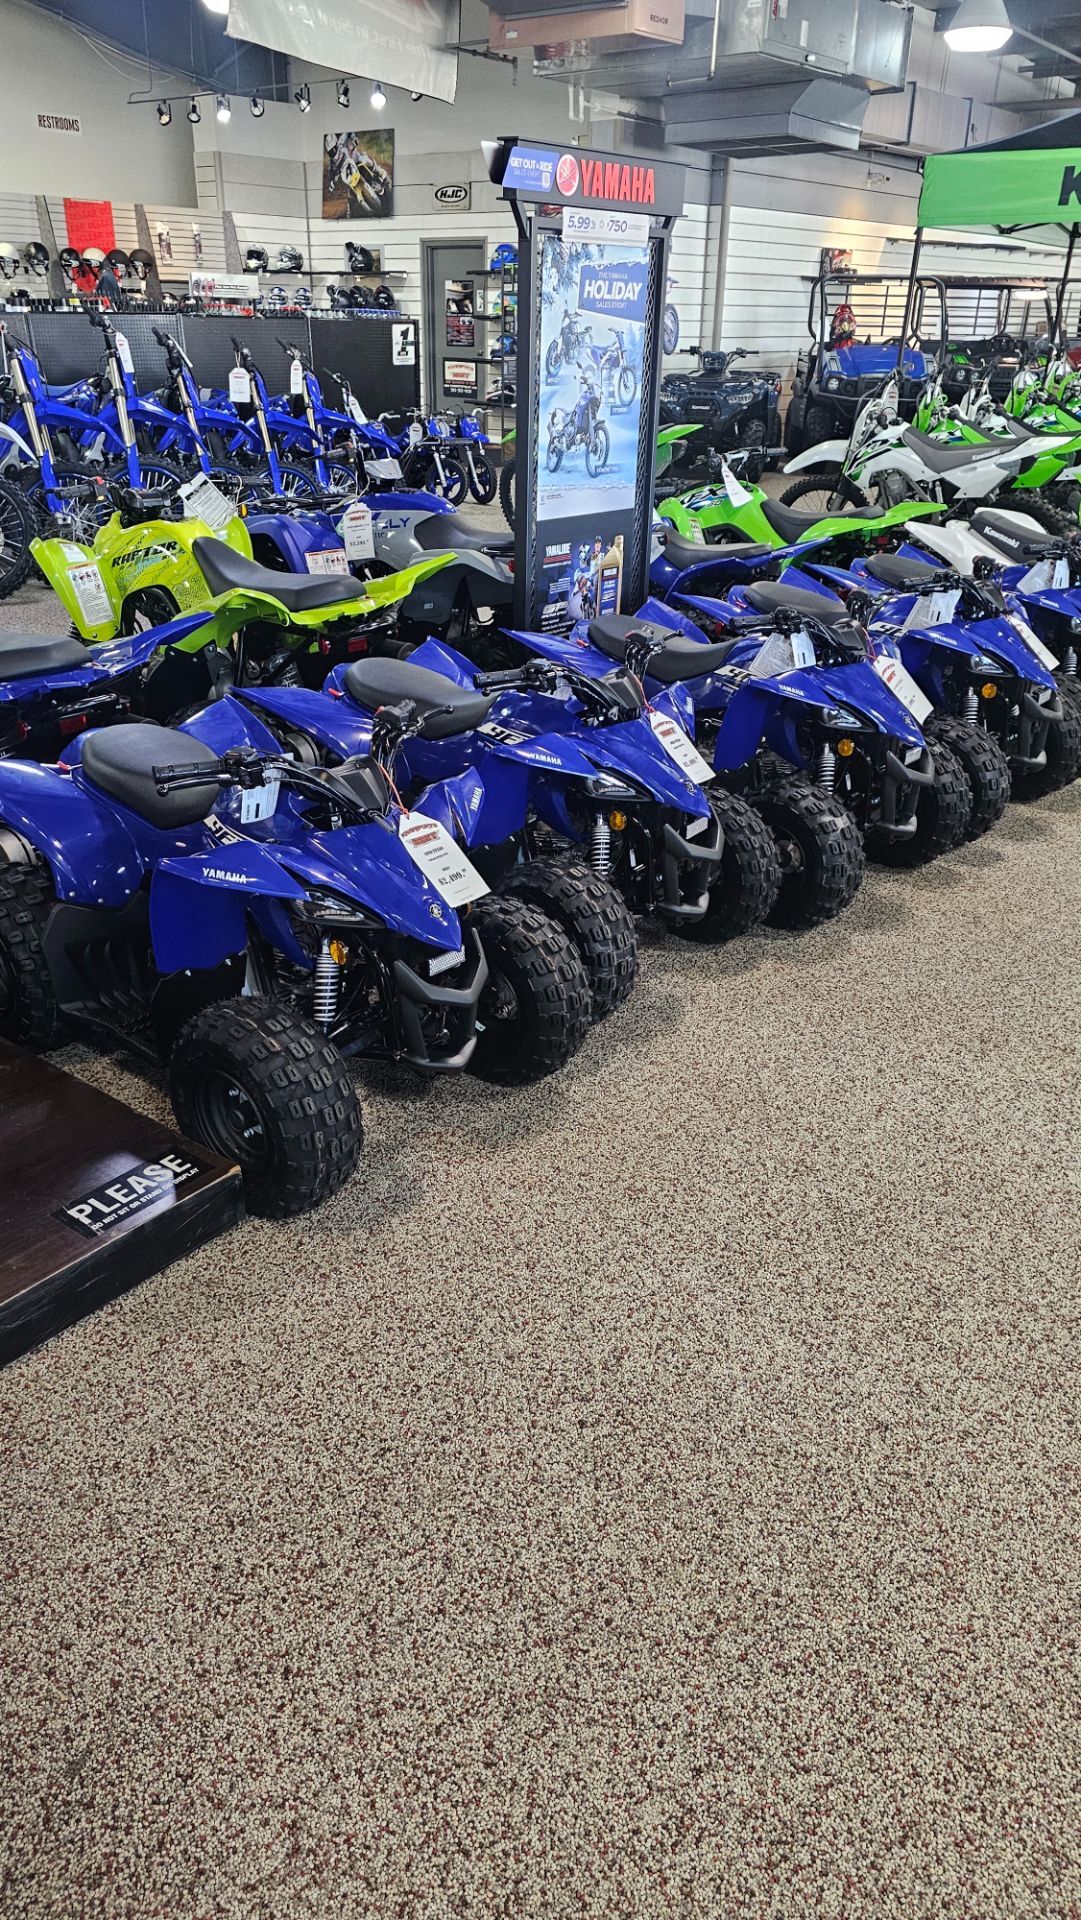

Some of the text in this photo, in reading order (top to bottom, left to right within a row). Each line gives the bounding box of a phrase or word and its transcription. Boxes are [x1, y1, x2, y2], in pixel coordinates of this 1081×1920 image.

[38, 114, 80, 132] RESTROOMS
[510, 157, 523, 168] GET
[523, 158, 536, 170] OUT
[540, 161, 553, 172] RIDE
[580, 158, 655, 205] YAMAHA
[440, 189, 463, 199] HJC
[583, 279, 643, 301] HOLIDAY
[972, 449, 1001, 462] Kawasaki
[983, 525, 1020, 548] Kawasaki
[112, 540, 178, 568] RAPTOR
[545, 542, 572, 557] YAMALUBE
[779, 684, 804, 697] YAMAHA
[529, 752, 562, 766] YAMAHA
[470, 787, 483, 811] YAMAHA
[202, 867, 247, 884] YAMAHA
[66, 1154, 192, 1226] PLEASE
[91, 1222, 103, 1231] DO
[104, 1213, 118, 1225] NOT
[117, 1206, 130, 1216] SIT
[129, 1199, 141, 1209] OR
[140, 1186, 163, 1203] STAND
[174, 1167, 199, 1185] DISPLAY
